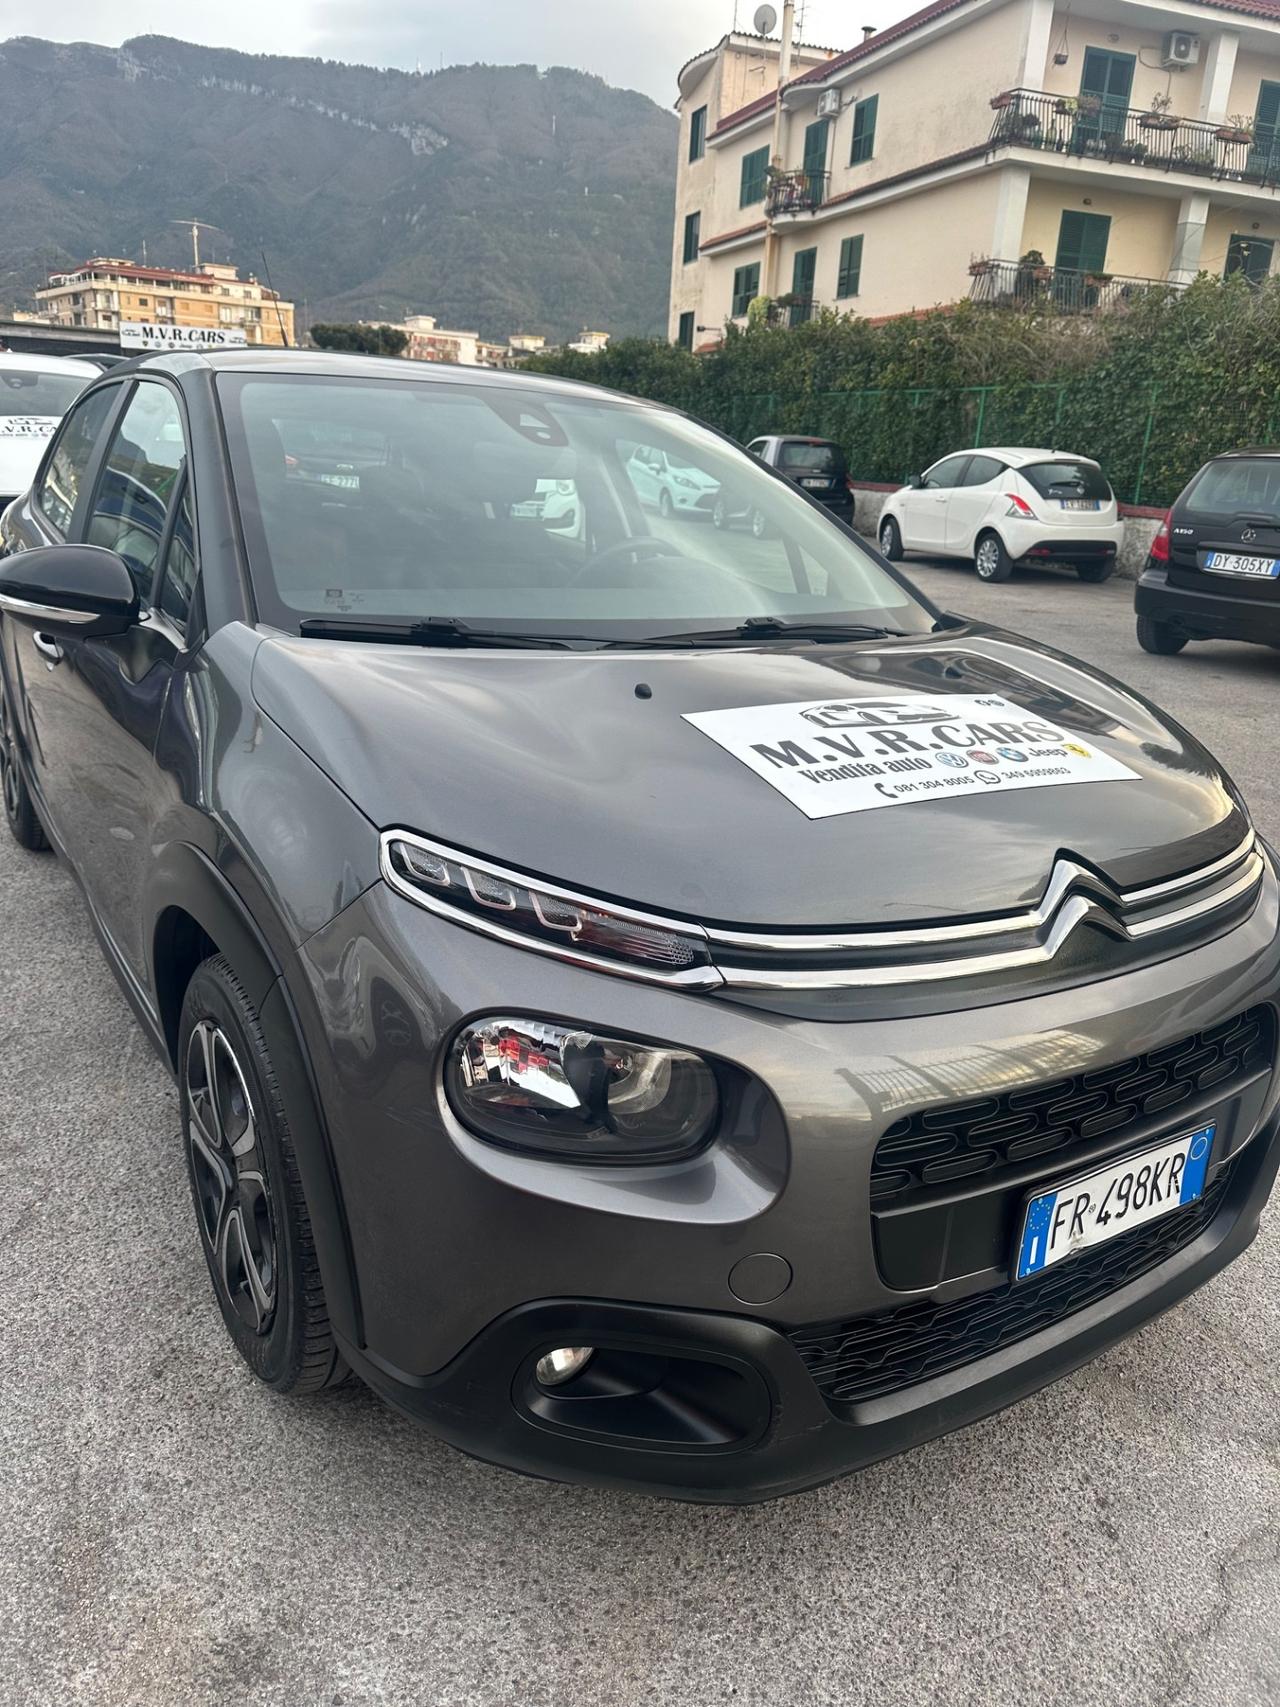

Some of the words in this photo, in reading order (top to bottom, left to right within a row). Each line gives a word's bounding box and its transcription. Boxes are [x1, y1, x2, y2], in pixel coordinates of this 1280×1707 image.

[1213, 554, 1231, 568] DY
[1232, 557, 1274, 573] 305XY
[1027, 747, 1068, 757] Jeep
[797, 762, 887, 784] Vendita
[882, 756, 933, 773] auto
[893, 782, 919, 793] 081
[918, 779, 944, 790] 304
[942, 775, 975, 787] 8005
[1000, 769, 1025, 779] 349
[1050, 1192, 1092, 1250] FR
[1096, 1152, 1187, 1226] 498KR
